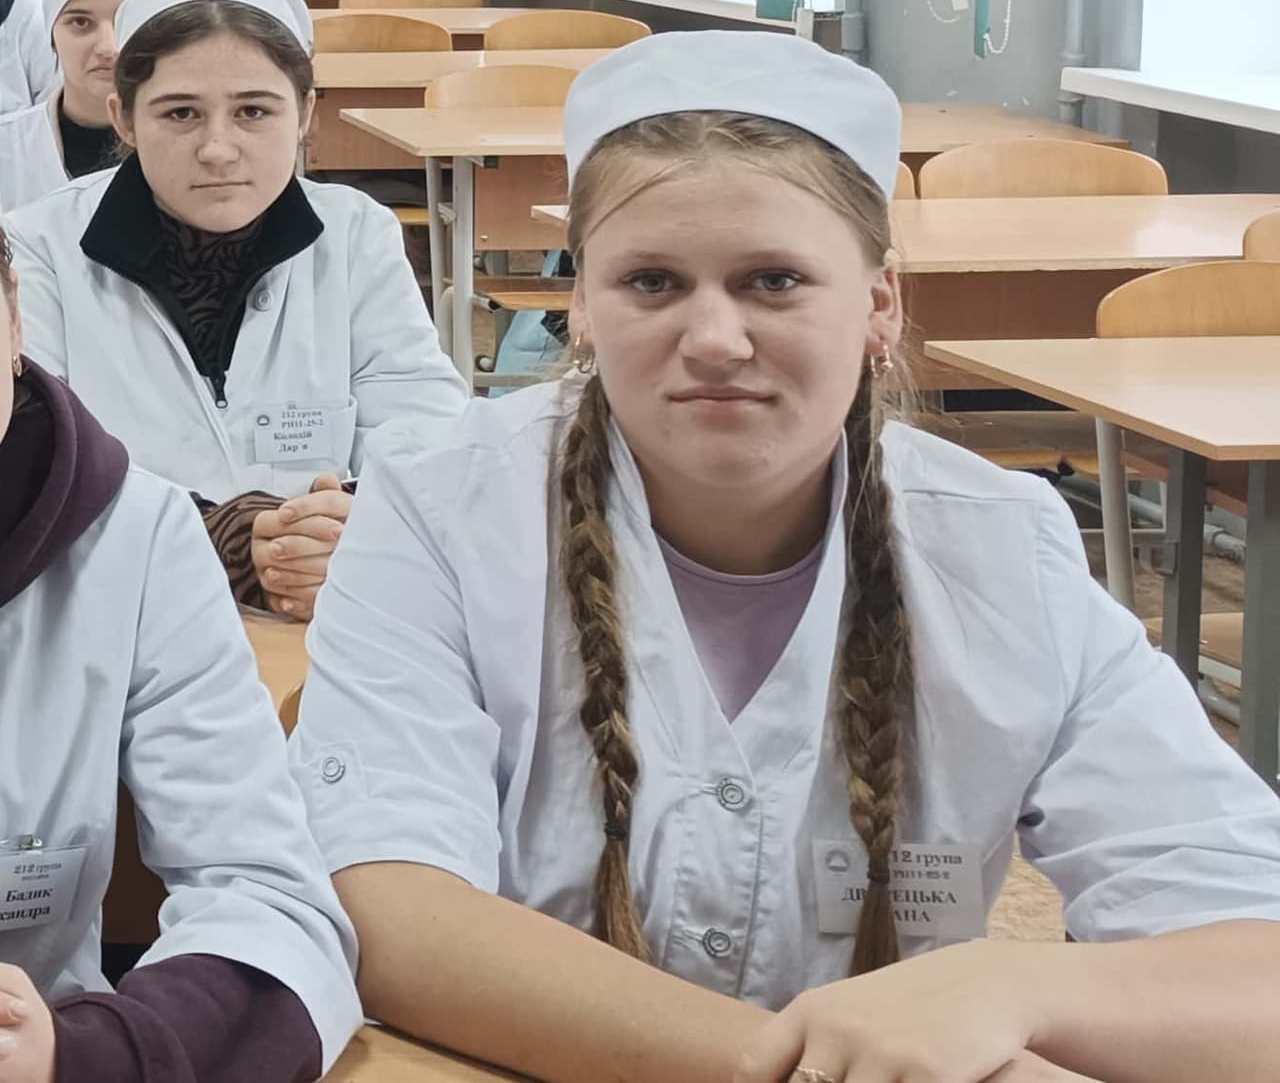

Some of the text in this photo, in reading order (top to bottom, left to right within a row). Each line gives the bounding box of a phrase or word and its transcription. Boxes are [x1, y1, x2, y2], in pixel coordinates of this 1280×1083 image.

[892, 850, 963, 867] 12 група
[842, 887, 957, 905] ДВЕЦЬКА
